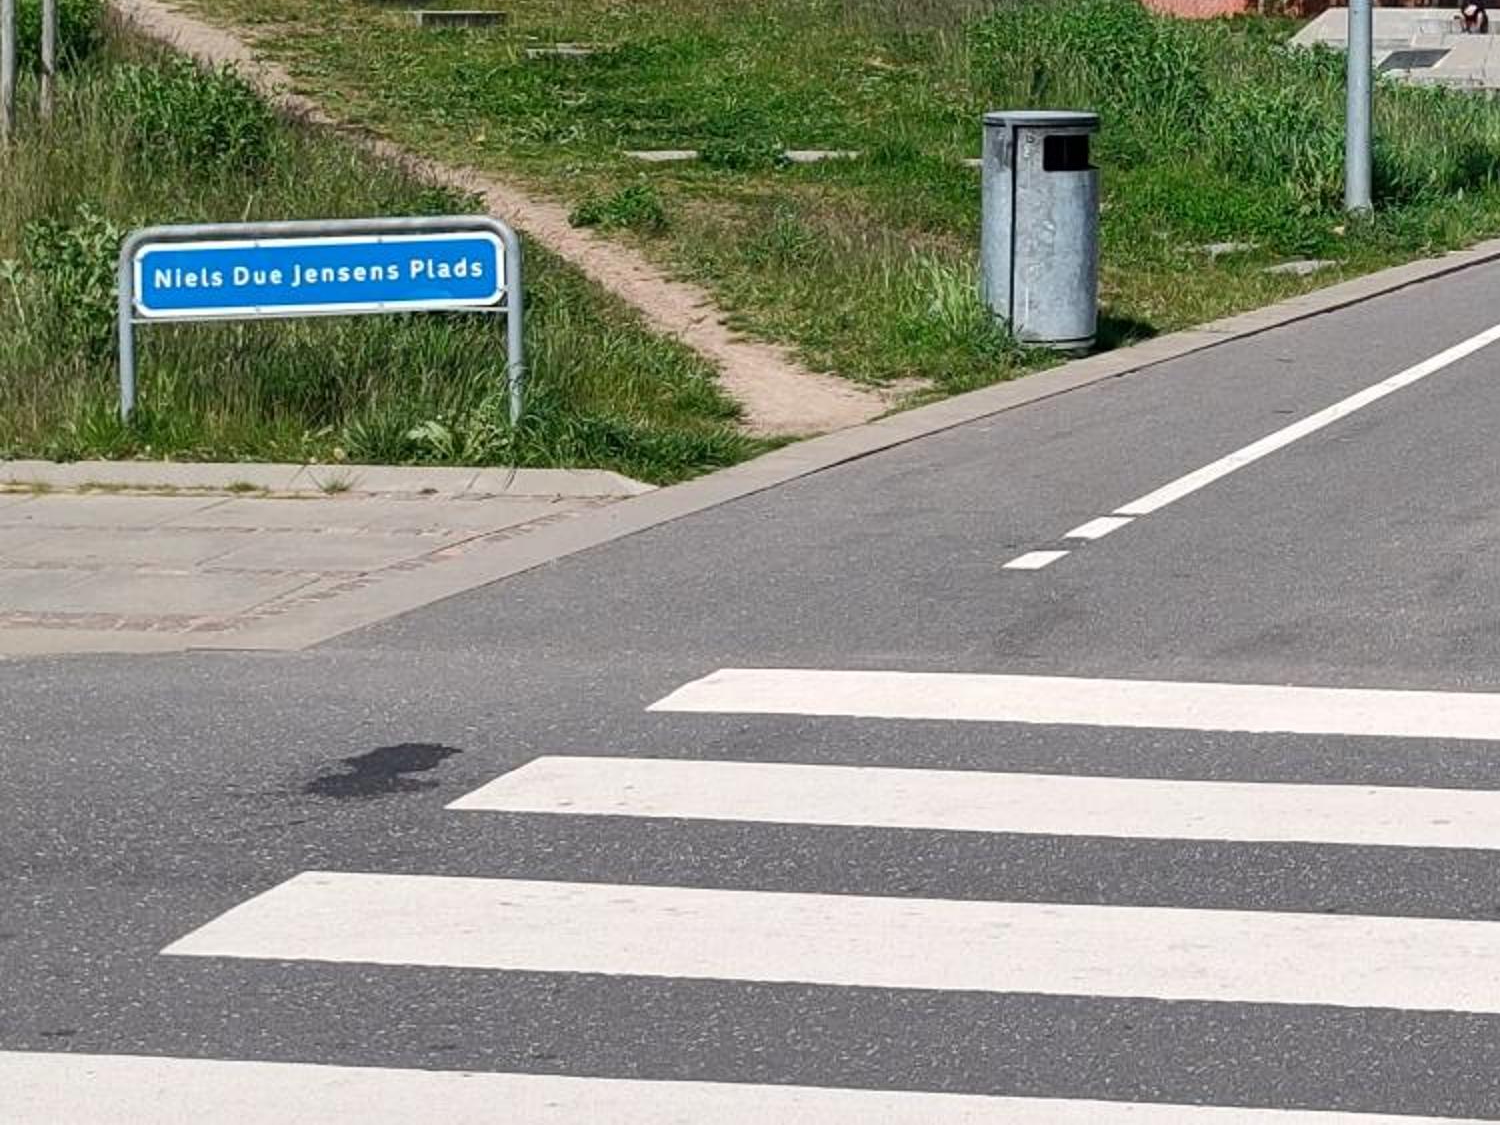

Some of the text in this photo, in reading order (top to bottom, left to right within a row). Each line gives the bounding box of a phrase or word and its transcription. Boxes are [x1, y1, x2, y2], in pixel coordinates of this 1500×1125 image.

[154, 257, 483, 288] Niels Due Jensens Plads
